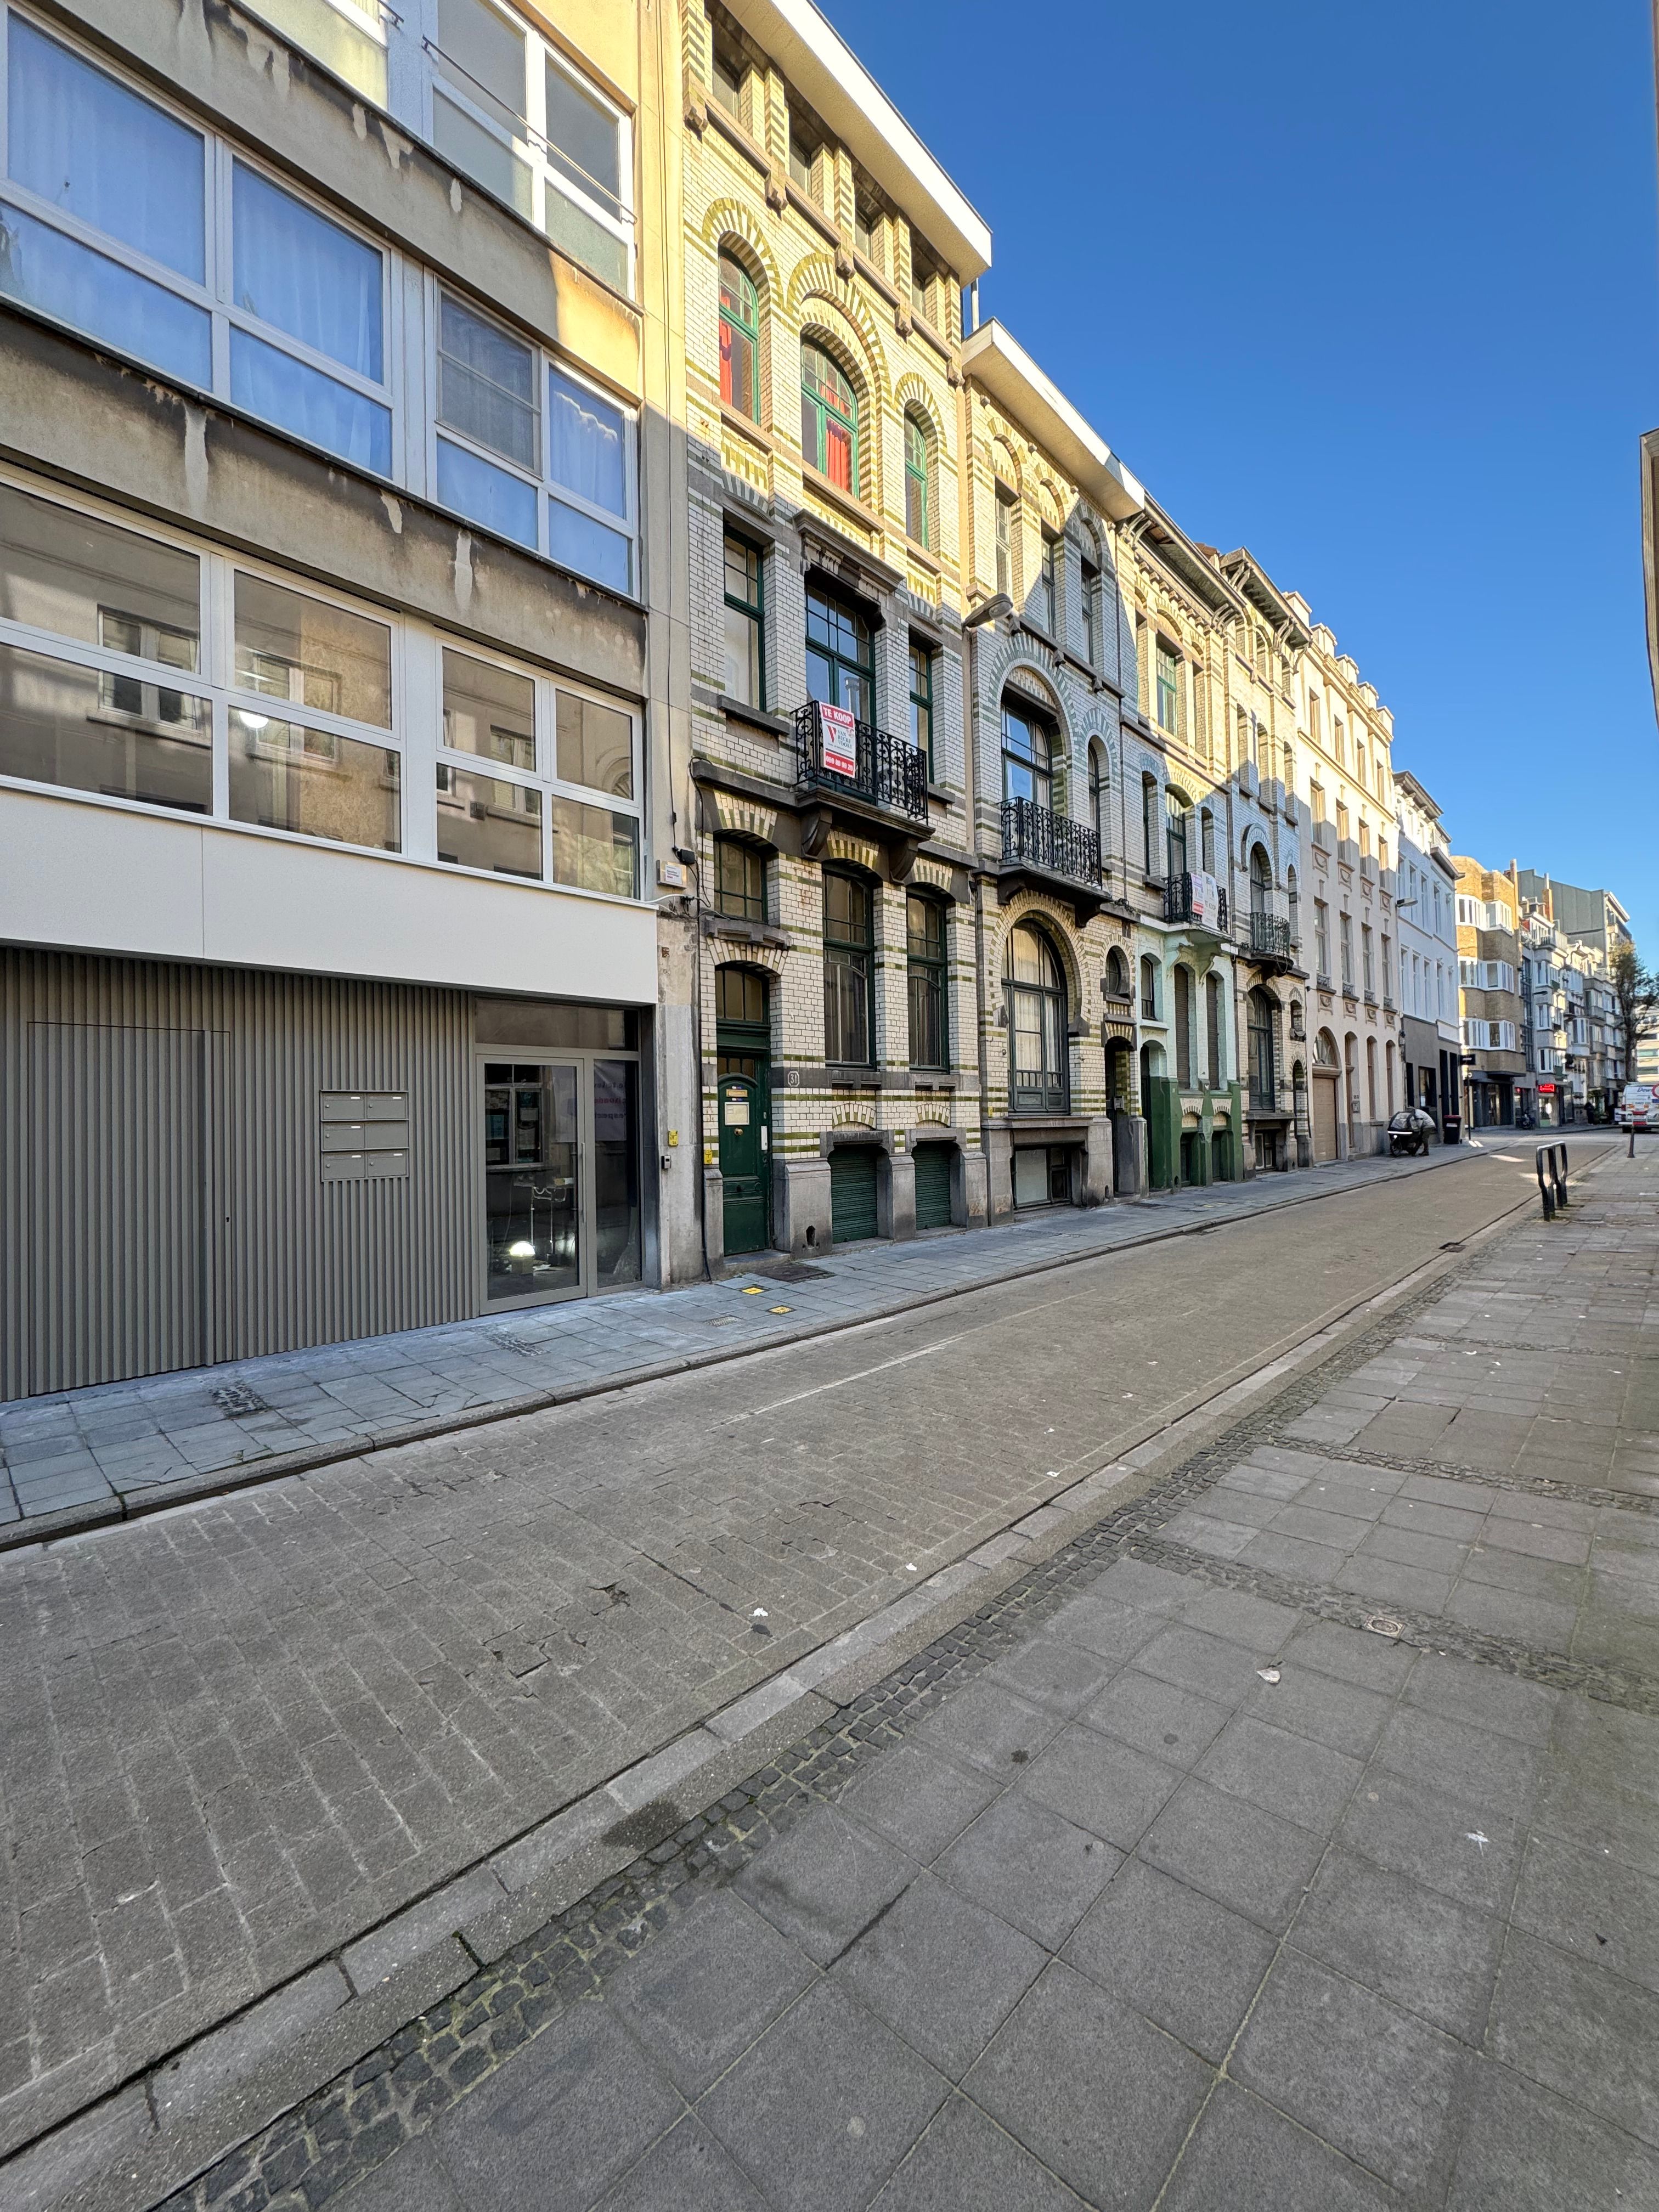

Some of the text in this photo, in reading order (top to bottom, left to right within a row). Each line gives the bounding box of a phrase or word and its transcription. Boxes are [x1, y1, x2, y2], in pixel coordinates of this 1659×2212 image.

[823, 707, 851, 725] TE KOOP
[790, 1074, 797, 1084] 31
